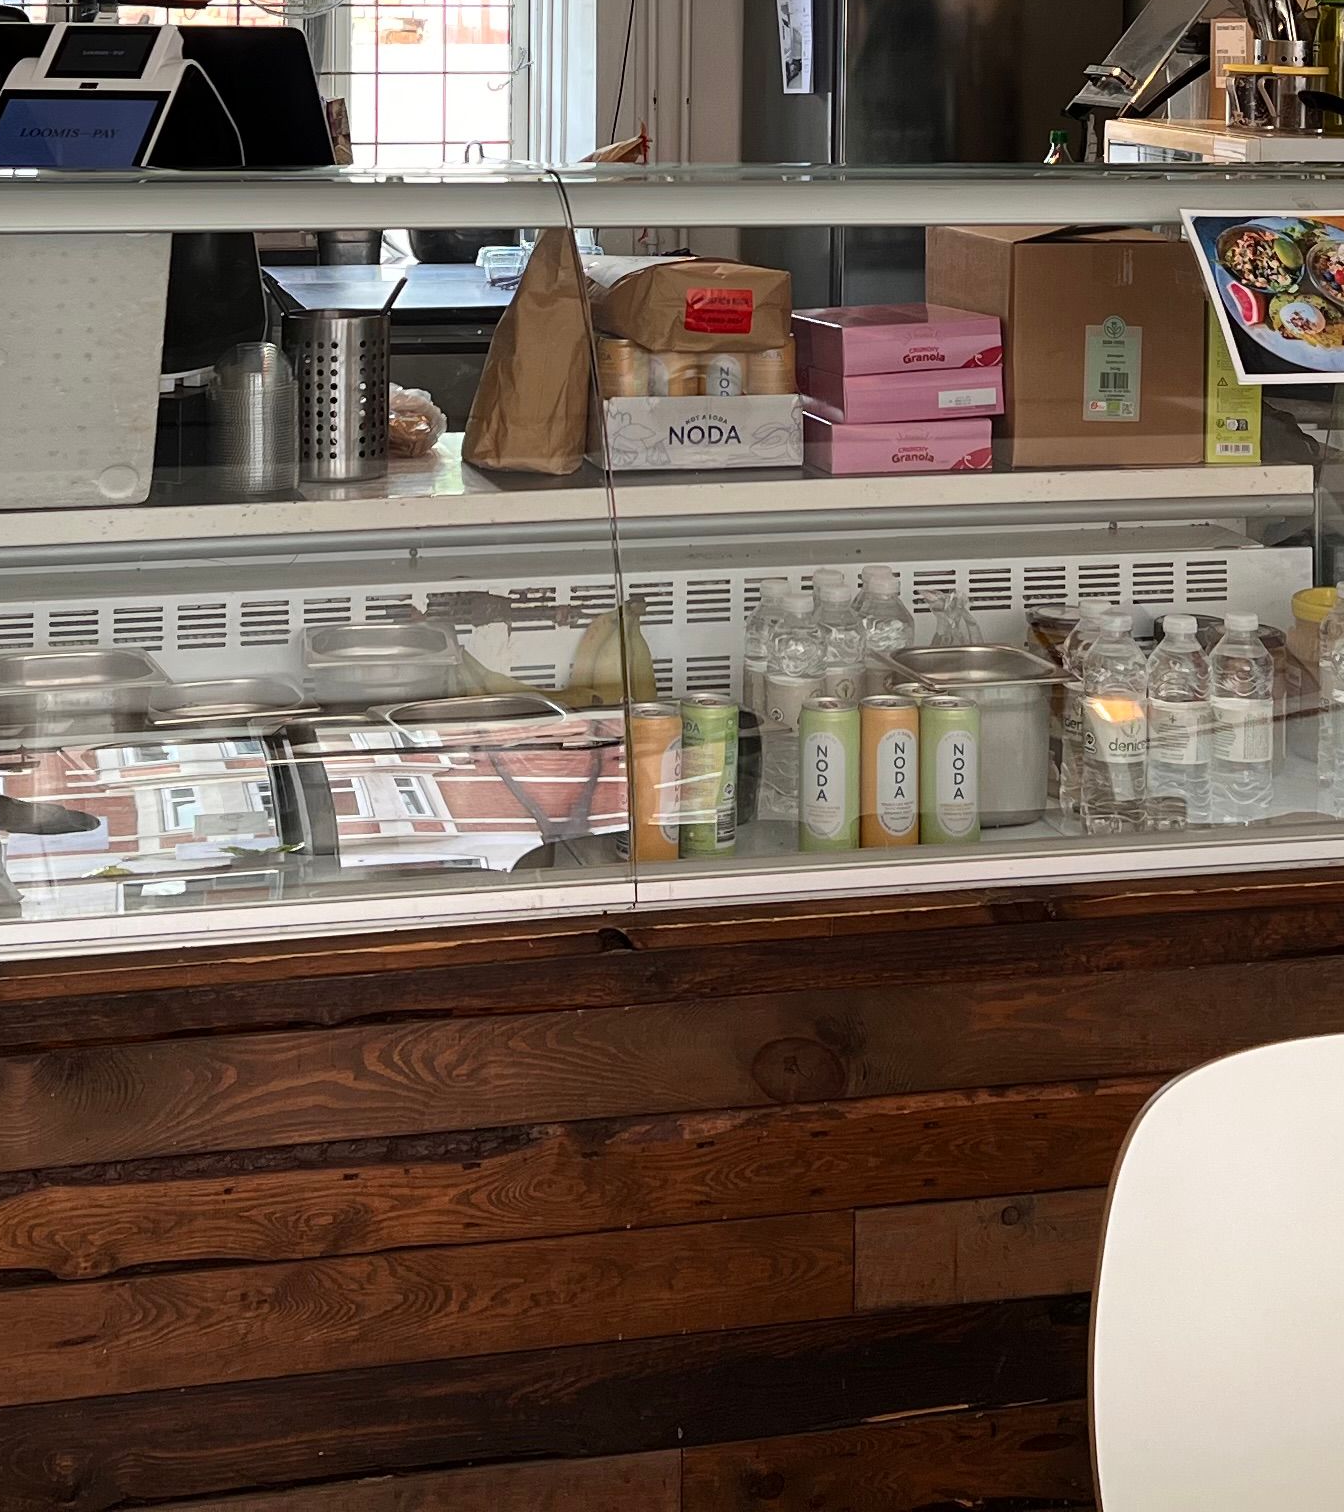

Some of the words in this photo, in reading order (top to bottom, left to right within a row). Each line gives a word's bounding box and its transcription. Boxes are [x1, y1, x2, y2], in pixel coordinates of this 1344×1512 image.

[903, 352, 945, 364] Granola
[668, 425, 741, 445] NODA
[892, 452, 934, 464] Granola
[816, 744, 828, 802] NODA
[894, 742, 905, 799] NODA
[953, 743, 965, 800] NODA
